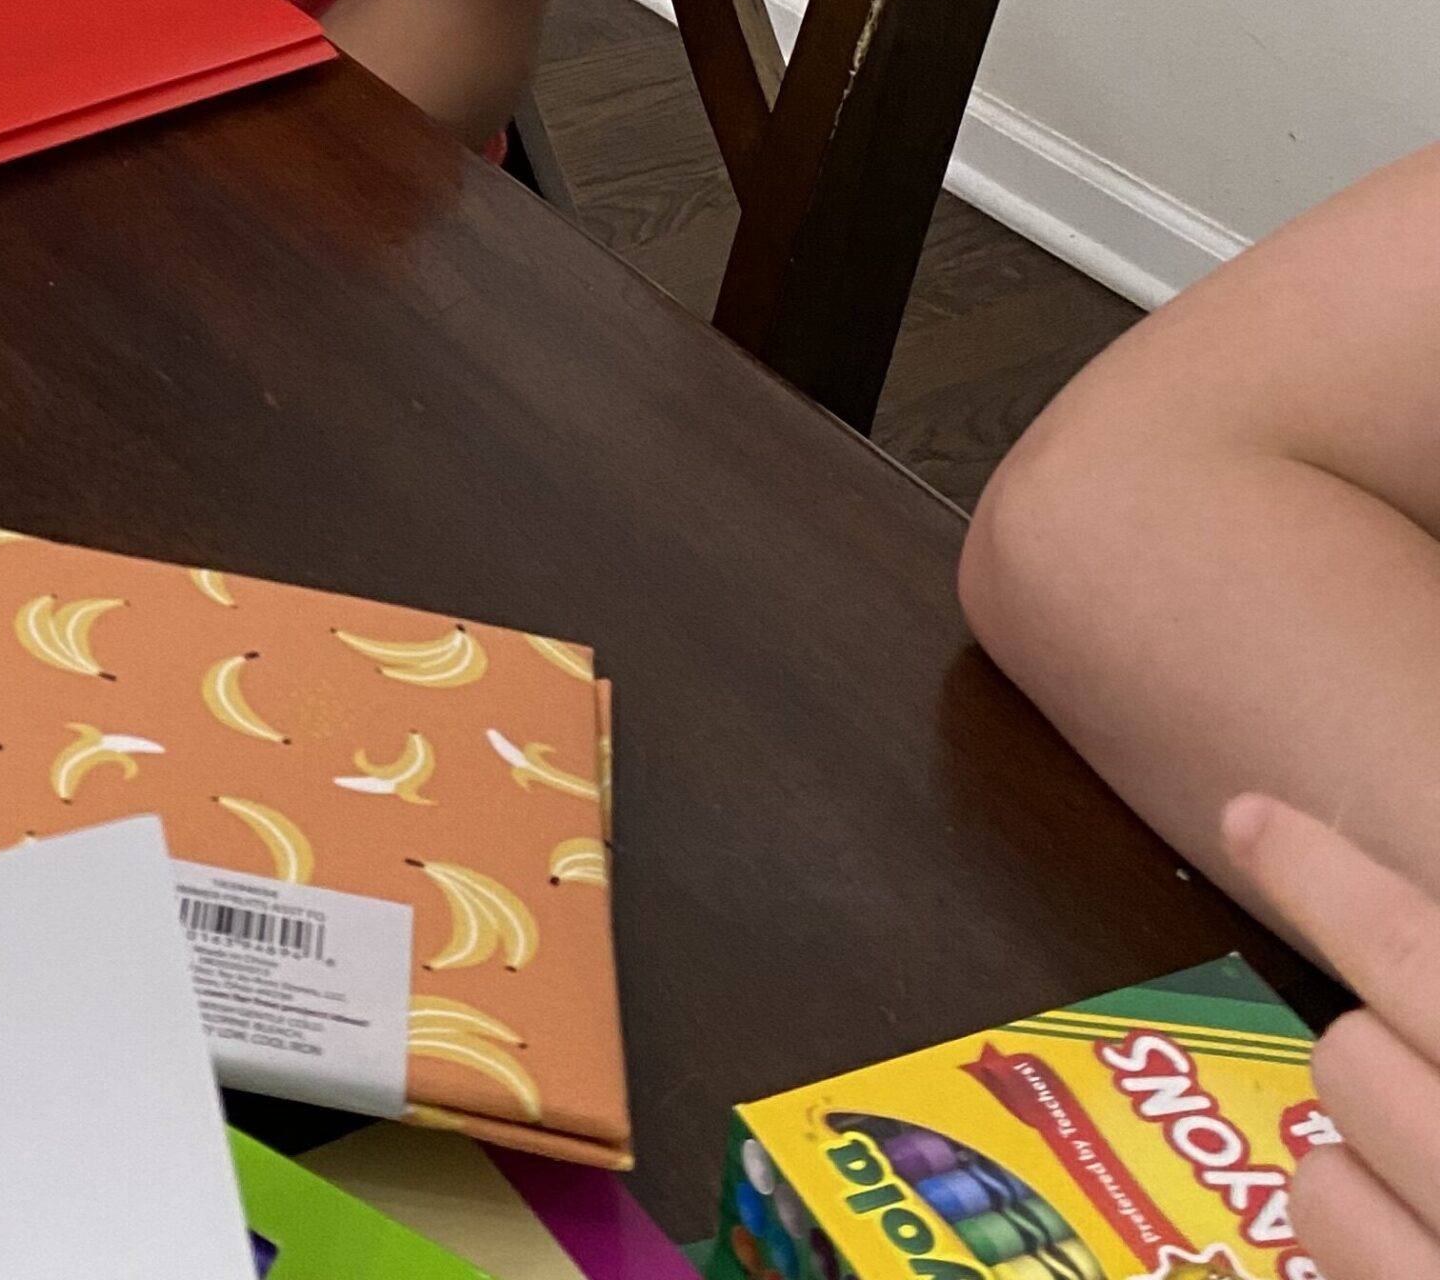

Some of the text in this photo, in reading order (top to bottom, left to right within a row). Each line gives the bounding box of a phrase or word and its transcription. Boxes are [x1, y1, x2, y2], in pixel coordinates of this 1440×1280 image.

[1013, 1061, 1162, 1244] Preferred by Teachers!
